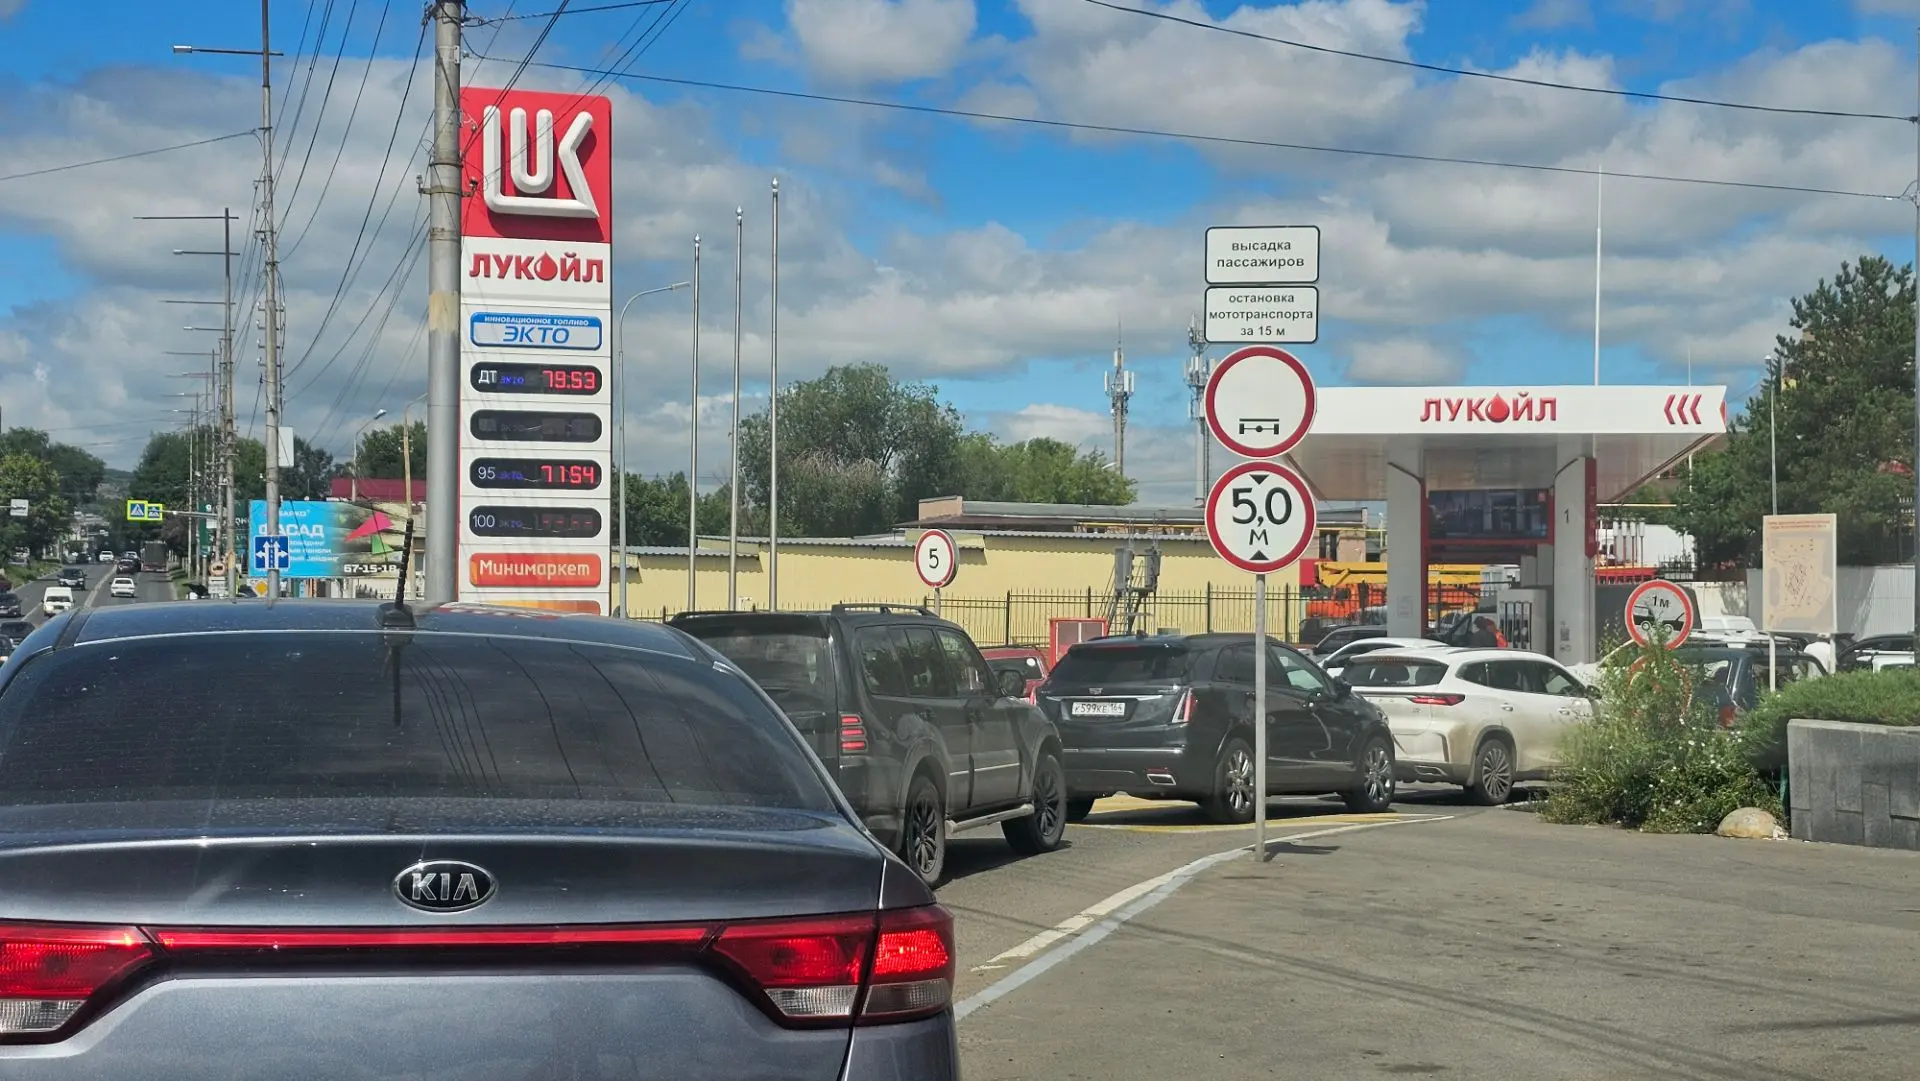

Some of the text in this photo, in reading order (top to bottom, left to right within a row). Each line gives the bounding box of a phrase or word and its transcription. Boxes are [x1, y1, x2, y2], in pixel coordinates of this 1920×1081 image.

[1232, 242, 1291, 251] высадка
[469, 250, 604, 283] ЛУКОЙЛ
[1217, 259, 1304, 269] пассажиров
[1228, 295, 1295, 303] остановка
[1209, 311, 1313, 321] мототранспорта
[502, 325, 569, 344] ЭКТО
[1258, 326, 1272, 336] 15
[1276, 327, 1285, 335] м
[478, 370, 497, 384] ДТ
[542, 370, 596, 389] 79.53
[1420, 391, 1557, 423] ЛУКОЙЛ
[478, 466, 496, 480] 95
[1232, 487, 1292, 527] 5,0
[472, 514, 496, 528] 100
[1563, 508, 1570, 524] 1
[929, 548, 939, 568] 5
[344, 564, 396, 573] 67-15-18
[480, 560, 590, 579] Минимаркет
[1651, 595, 1659, 607] 1
[411, 872, 479, 901] KIA
